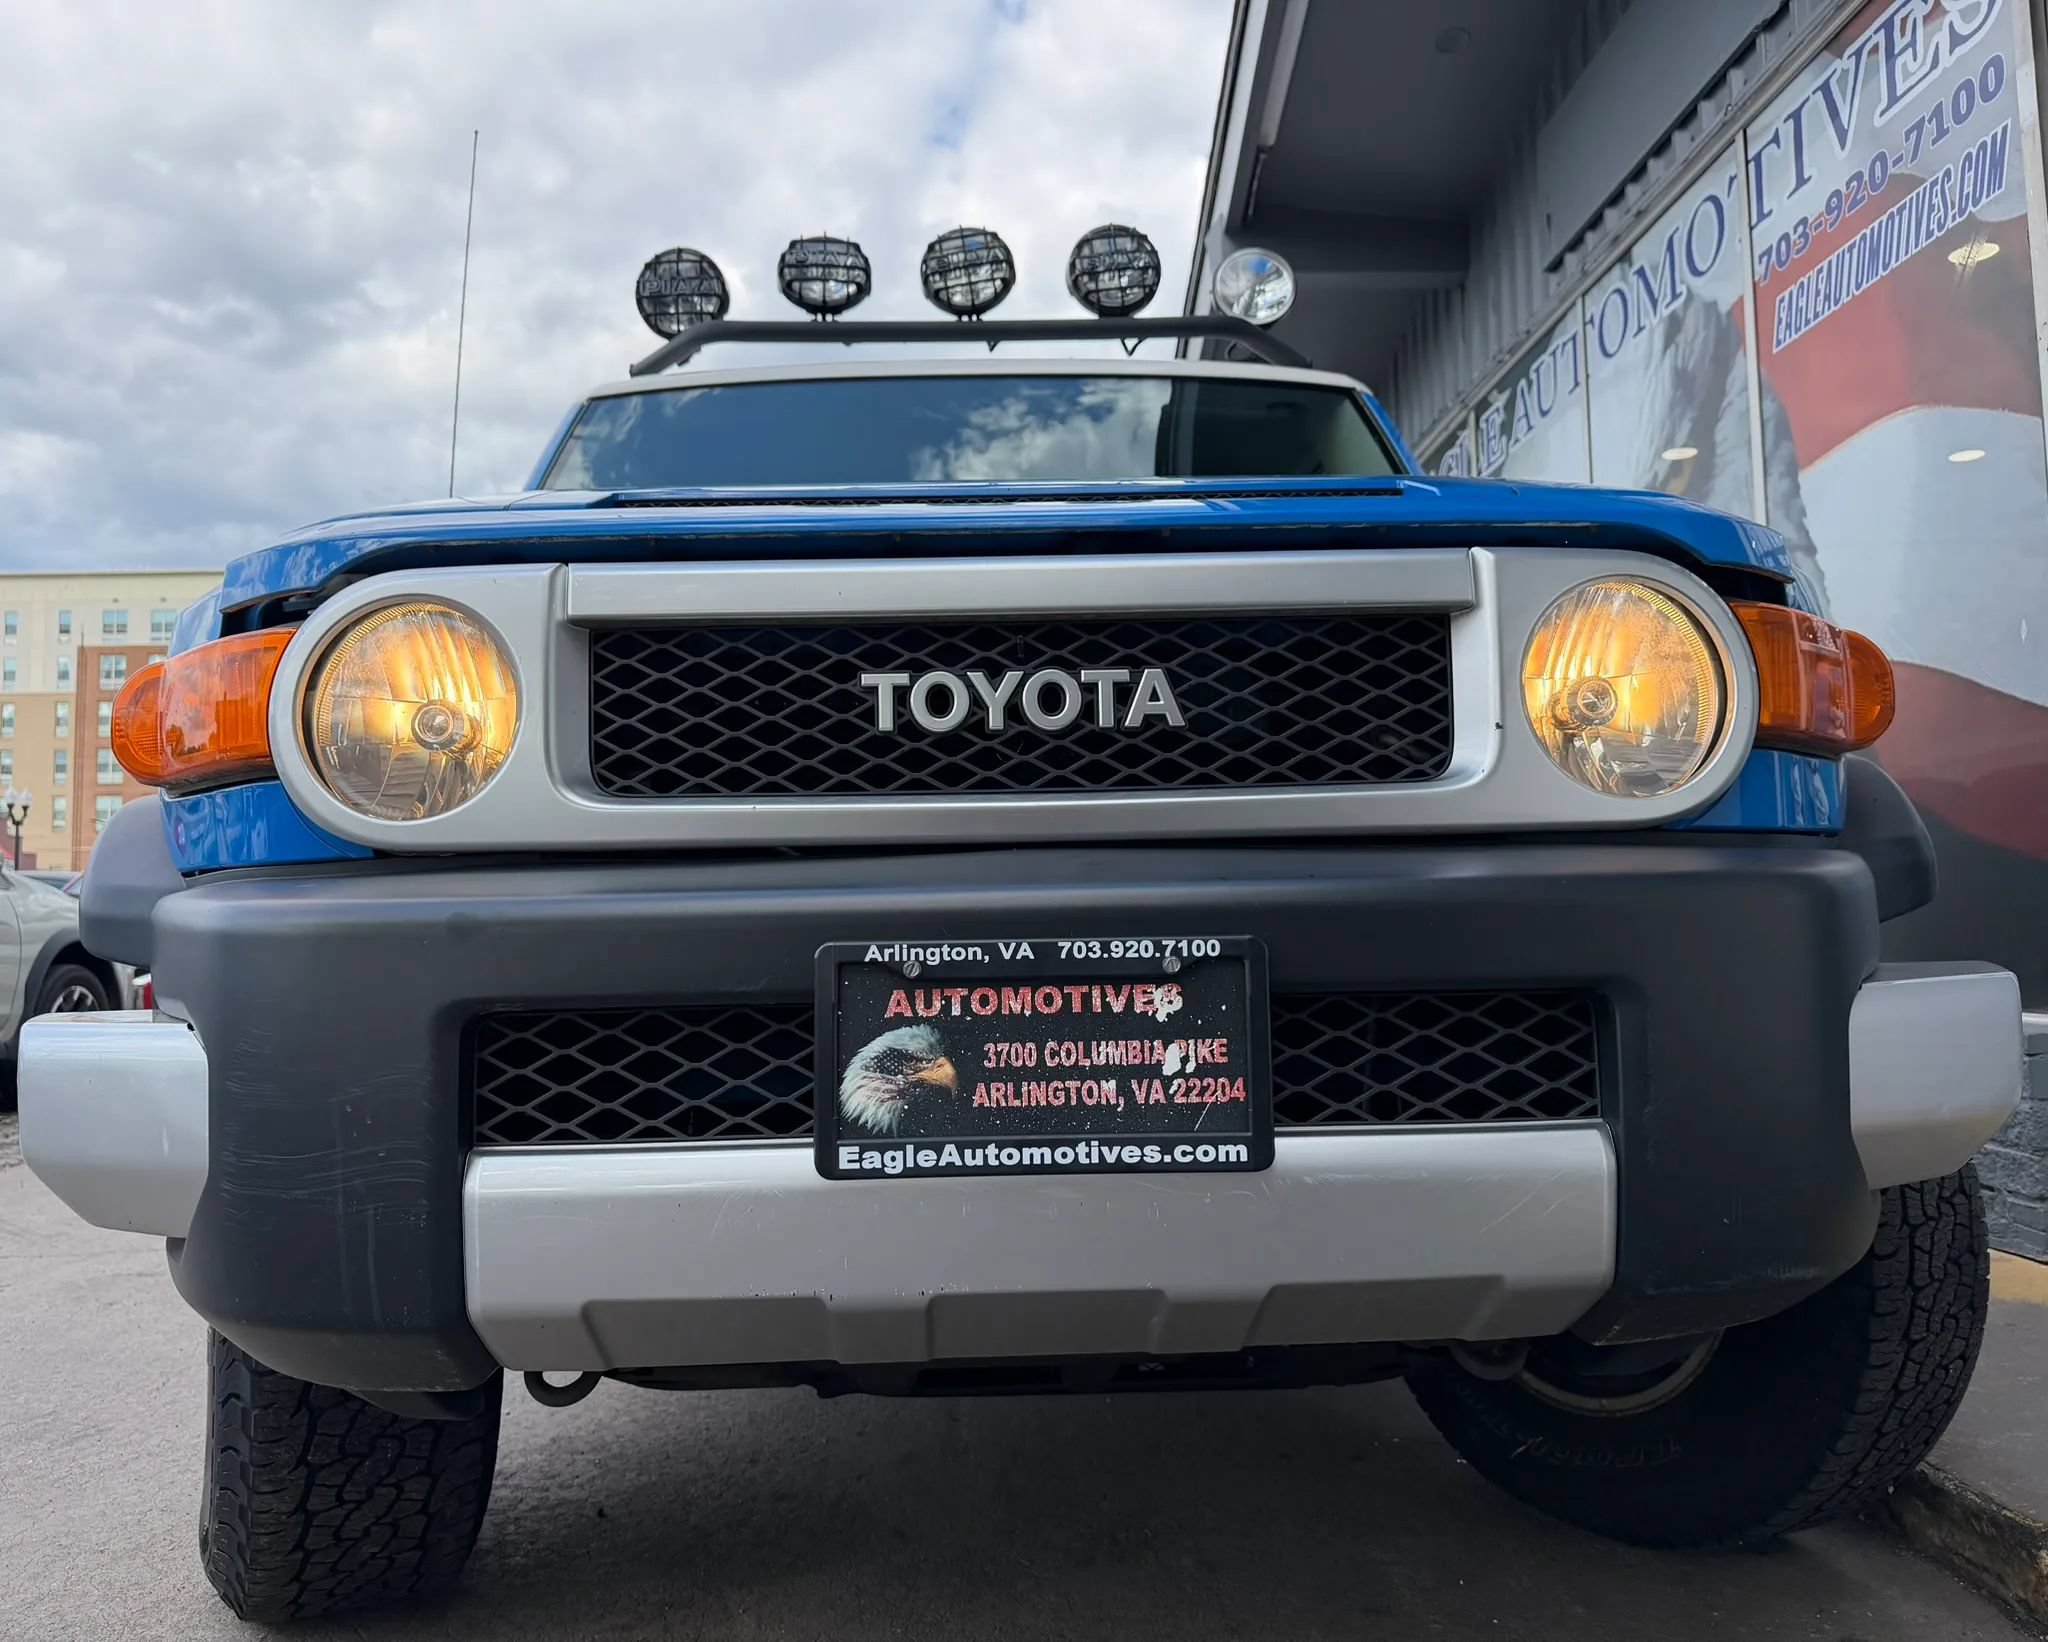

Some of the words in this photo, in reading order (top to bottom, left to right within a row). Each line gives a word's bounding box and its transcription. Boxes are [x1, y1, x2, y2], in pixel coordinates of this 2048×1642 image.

[1757, 51, 2006, 285] 703-920-7100
[1774, 120, 2010, 351] EAGLEAUTOMOTIVES.COM
[644, 277, 717, 296] PIAA
[860, 668, 1187, 732] TOYOTA
[864, 943, 990, 963] Arlington,
[999, 942, 1035, 961] VA
[1057, 939, 1221, 960] 703.920.7100
[884, 984, 1183, 1018] AUTOMOTIVES
[983, 1042, 1037, 1068] 3700
[1044, 1039, 1167, 1067] COLUMBIA
[972, 1079, 1125, 1112] ARLINGTON,
[1131, 1079, 1167, 1105] VA
[1171, 1077, 1246, 1104] 22204
[838, 1141, 1249, 1175] EagleAutomotives.com
